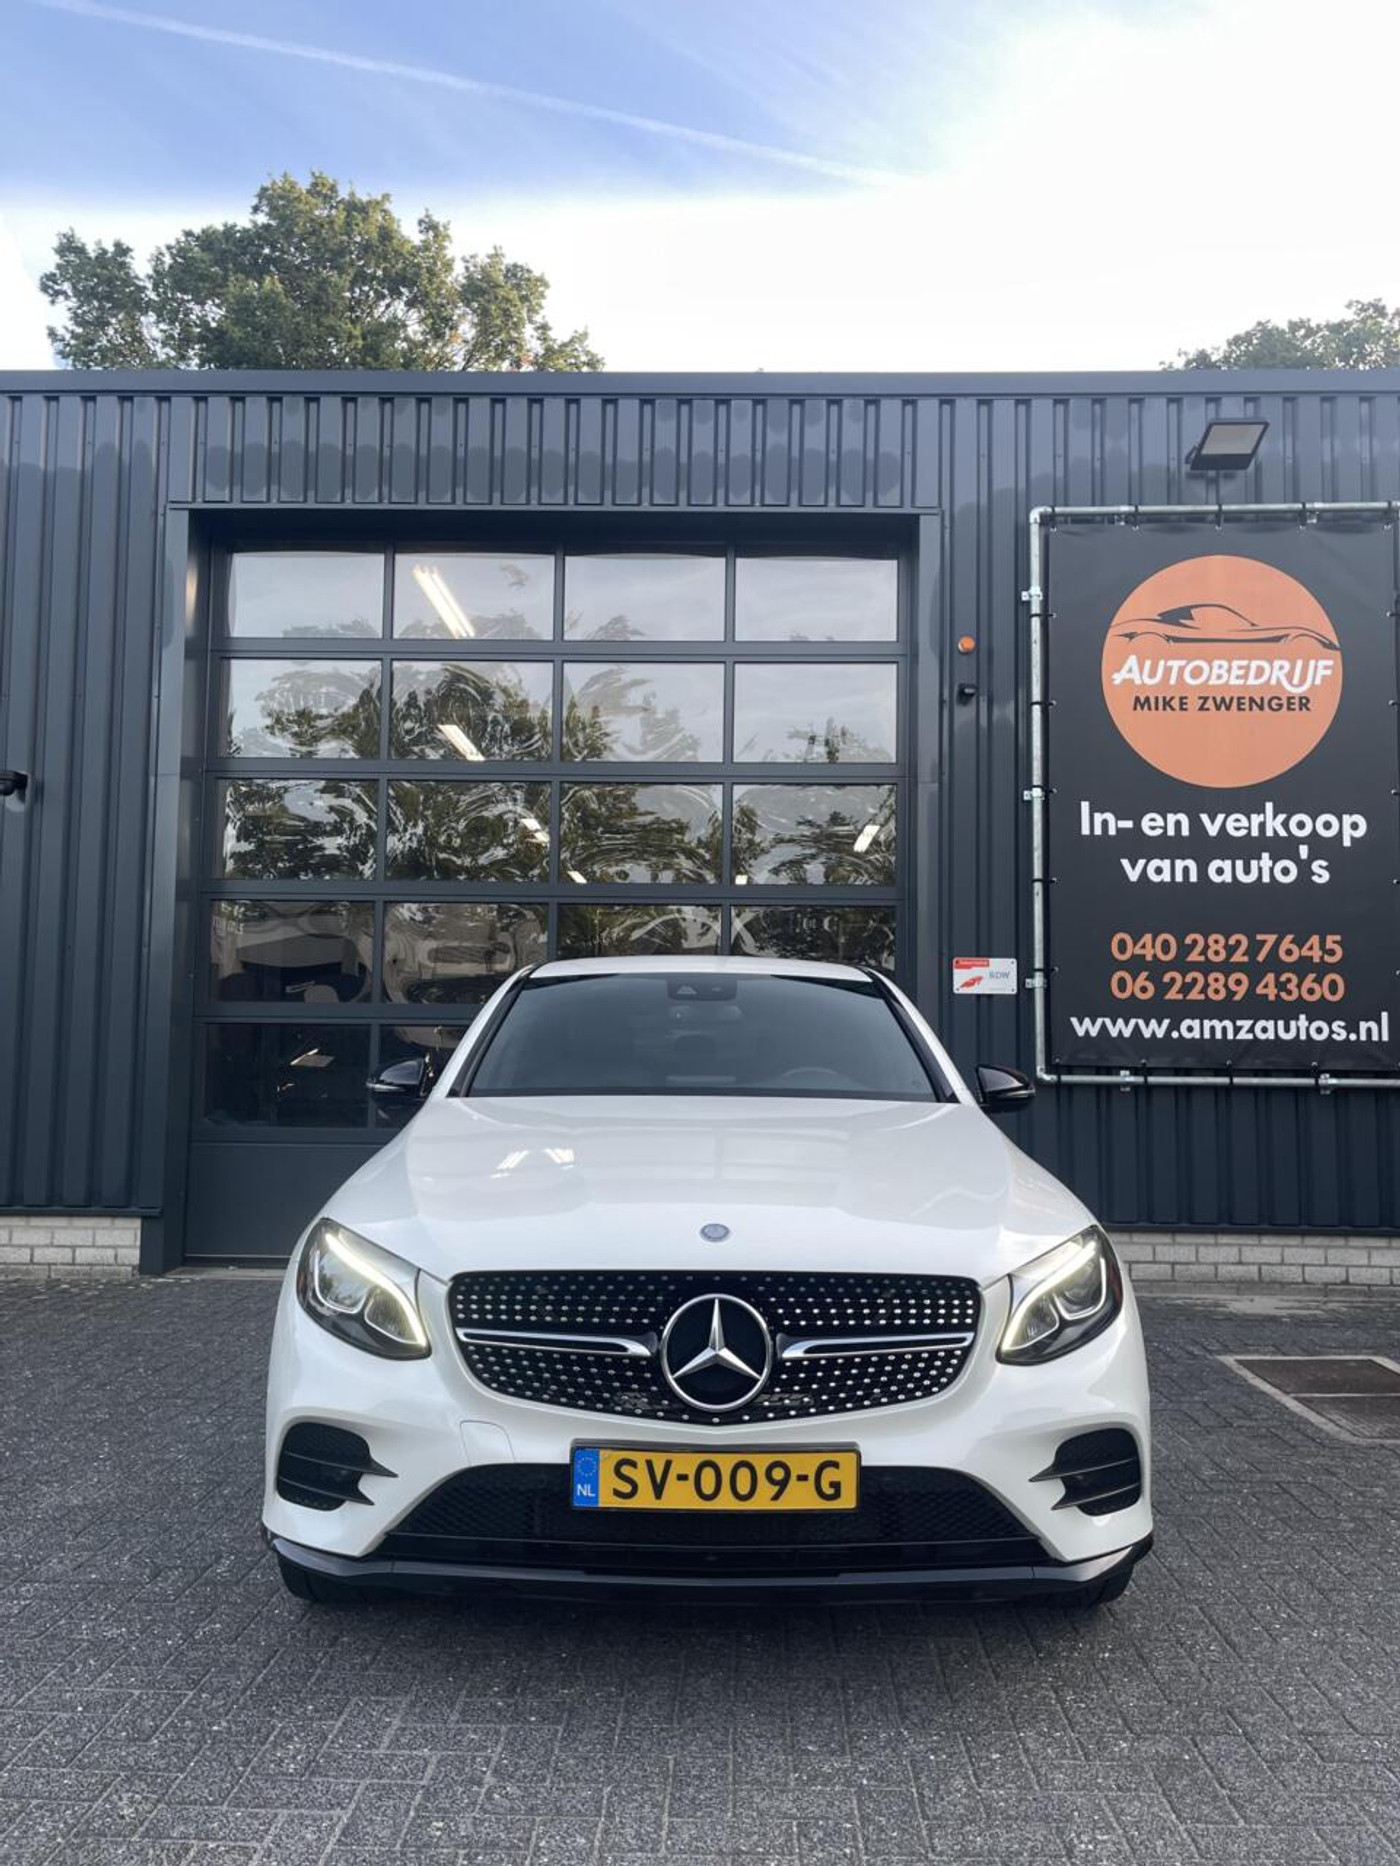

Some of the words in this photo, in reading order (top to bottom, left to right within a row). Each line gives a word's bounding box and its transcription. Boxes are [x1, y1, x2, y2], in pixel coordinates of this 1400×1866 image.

[1111, 654, 1334, 693] AUTOBEDRIJF
[1132, 696, 1190, 712] MIKE
[1197, 696, 1311, 712] ZWENGER
[1080, 801, 1133, 835] In-
[1141, 812, 1189, 836] en
[1200, 802, 1367, 847] verkoop
[1121, 858, 1198, 882] van
[1208, 845, 1330, 884] auto's
[1110, 932, 1177, 961] 040
[1184, 934, 1249, 962] 282
[1256, 934, 1343, 963] 7645
[1110, 971, 1155, 1000] 06
[1162, 972, 1249, 1001] 2289
[1256, 973, 1345, 1002] 4360
[1070, 1012, 1389, 1042] www.amzautos.nl
[577, 1484, 595, 1497] NL
[612, 1458, 842, 1501] SV-009-G
